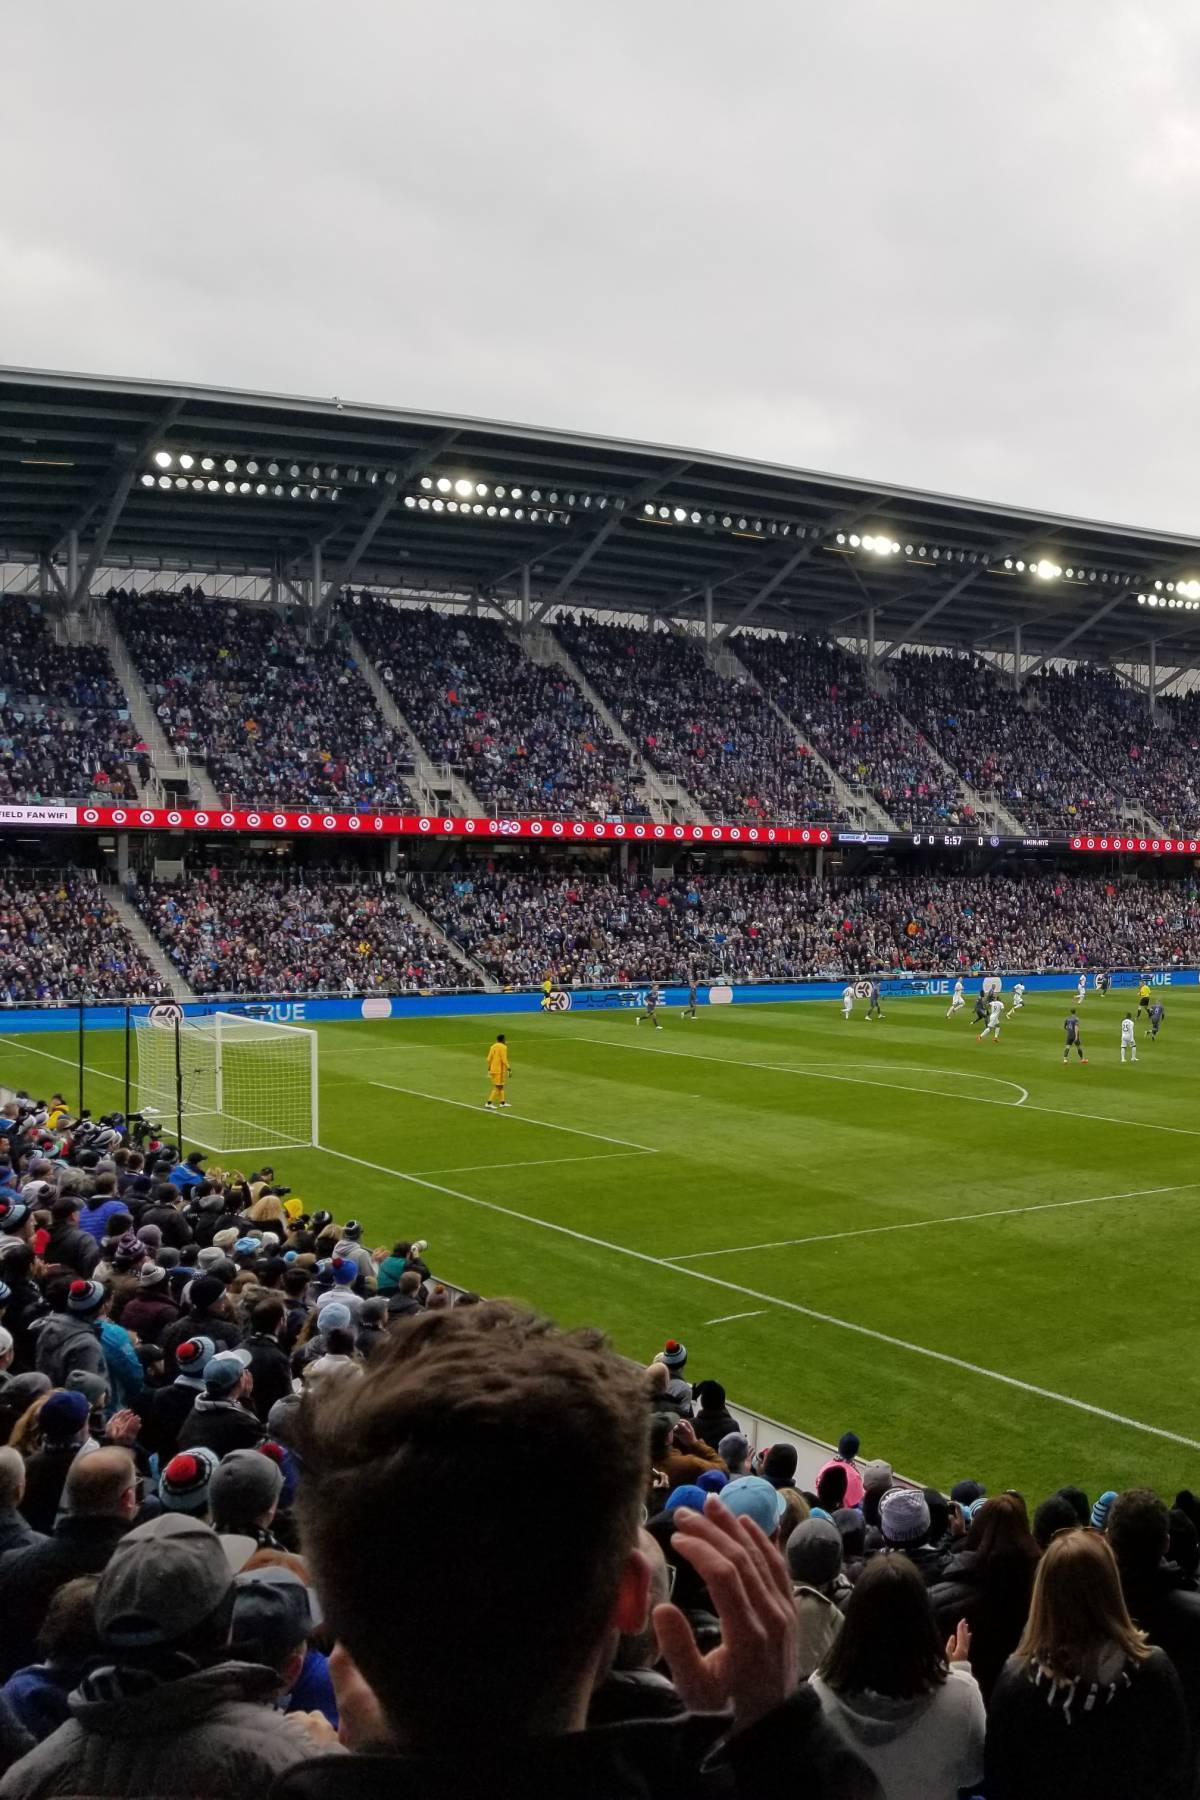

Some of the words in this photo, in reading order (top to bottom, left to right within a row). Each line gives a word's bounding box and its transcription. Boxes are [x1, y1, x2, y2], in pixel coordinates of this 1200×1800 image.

[27, 811, 45, 819] FAN
[928, 835, 934, 844] 0
[944, 836, 961, 845] 5:57
[977, 837, 984, 846] 0
